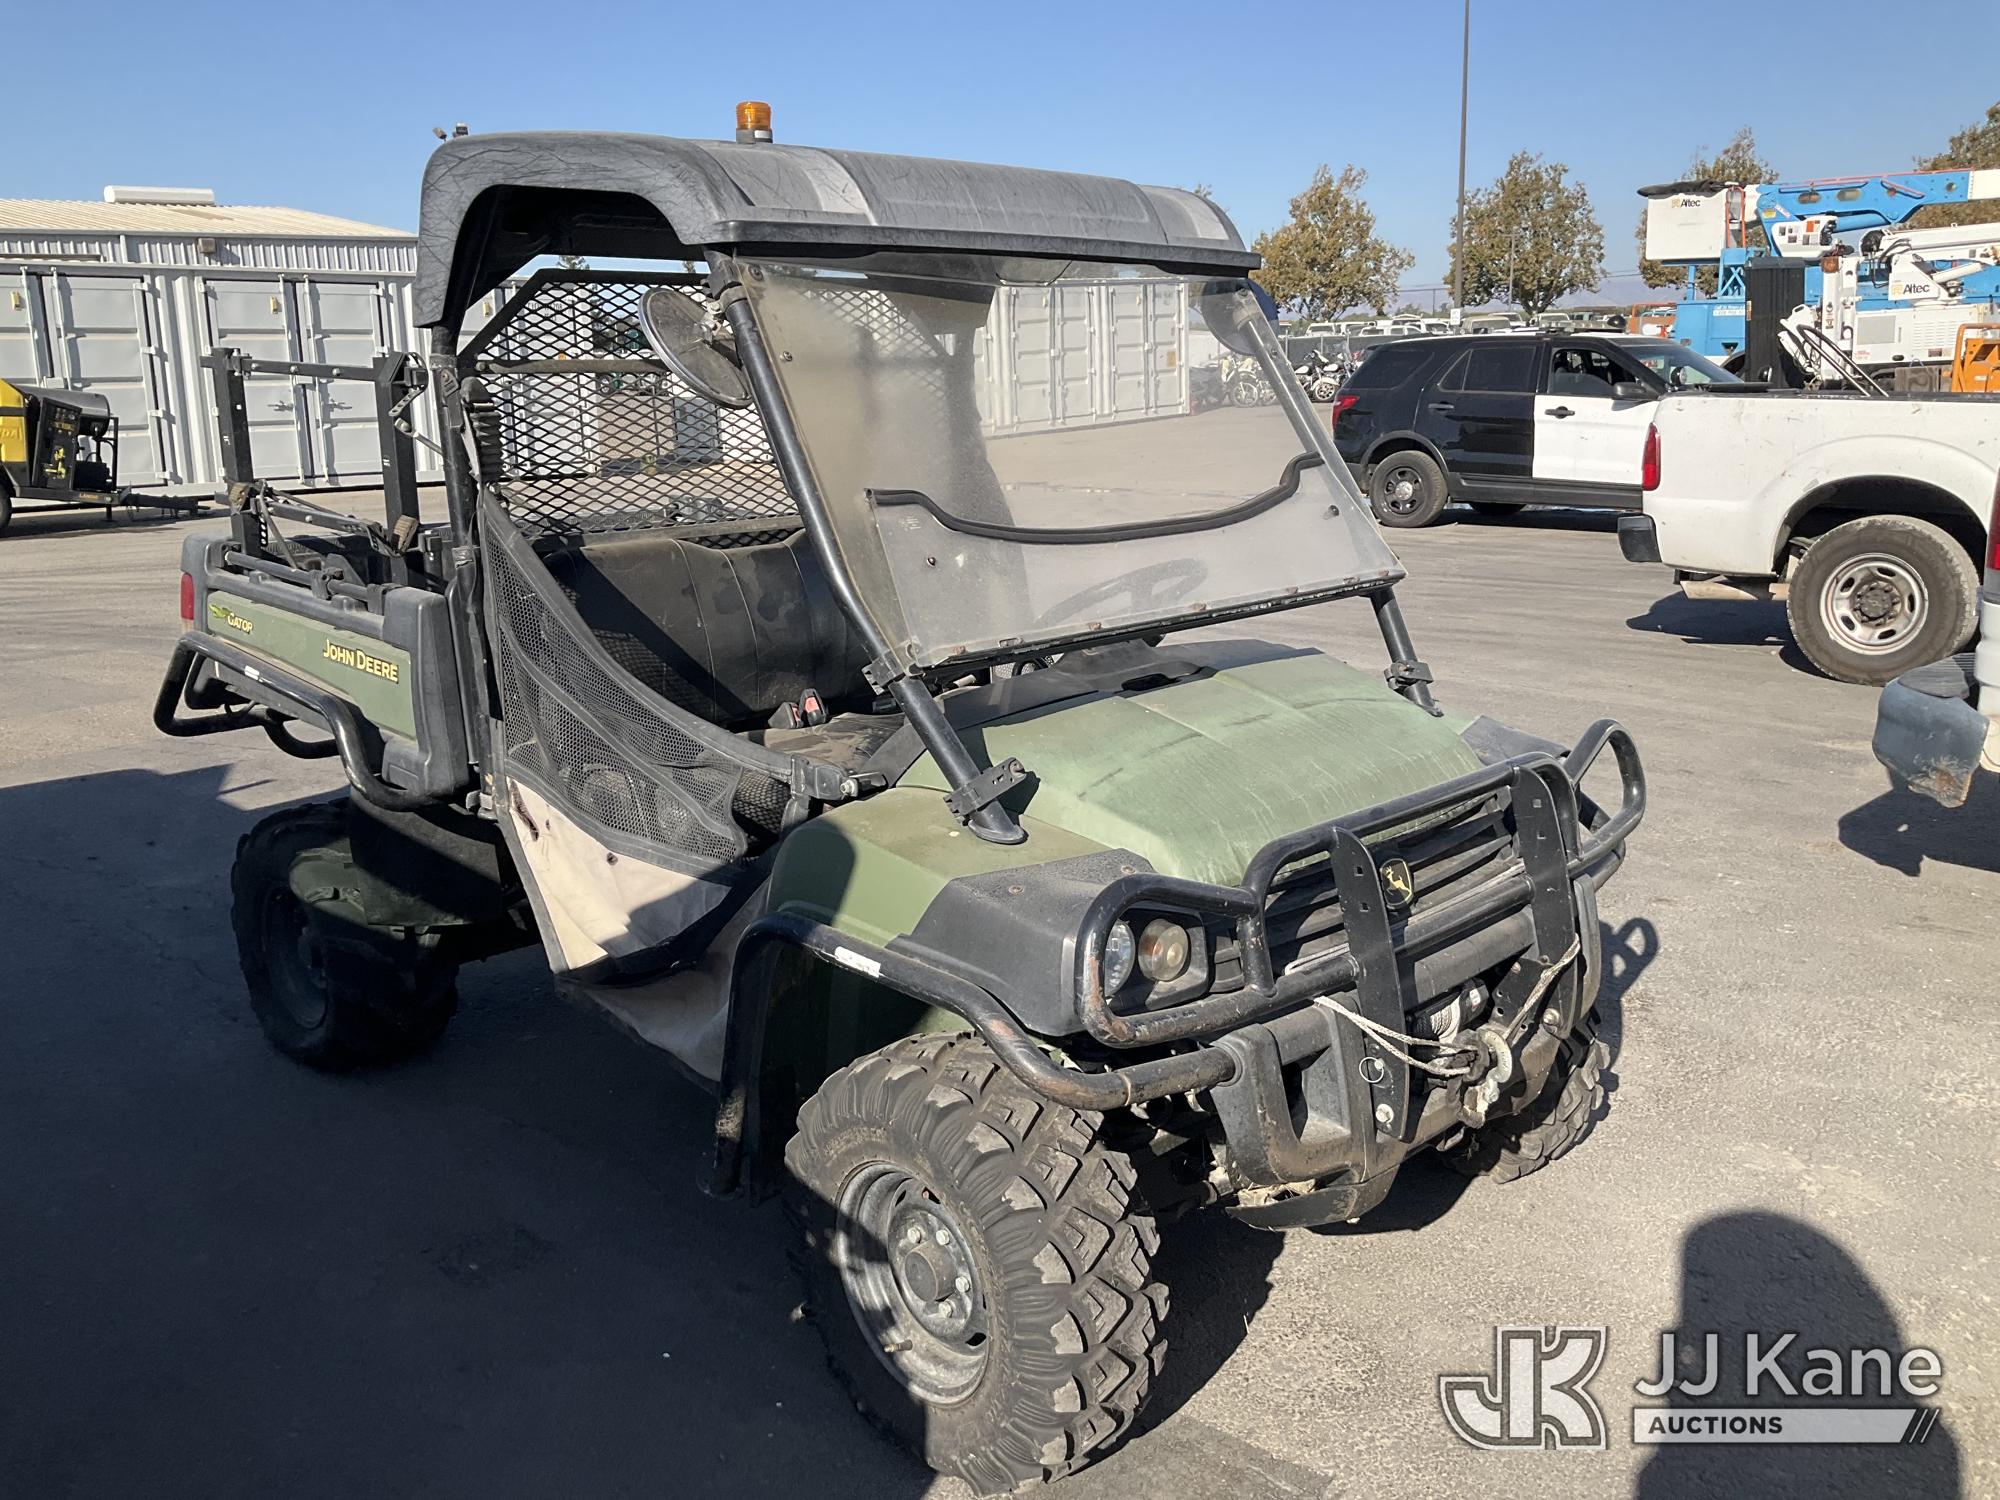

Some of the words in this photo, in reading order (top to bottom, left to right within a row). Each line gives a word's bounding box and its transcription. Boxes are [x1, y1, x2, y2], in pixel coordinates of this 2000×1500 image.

[1680, 198, 1701, 208] Altec
[1903, 282, 1931, 295] Altec
[227, 613, 253, 633] GATOR
[323, 639, 355, 668] JOHN
[356, 649, 398, 683] DEERE
